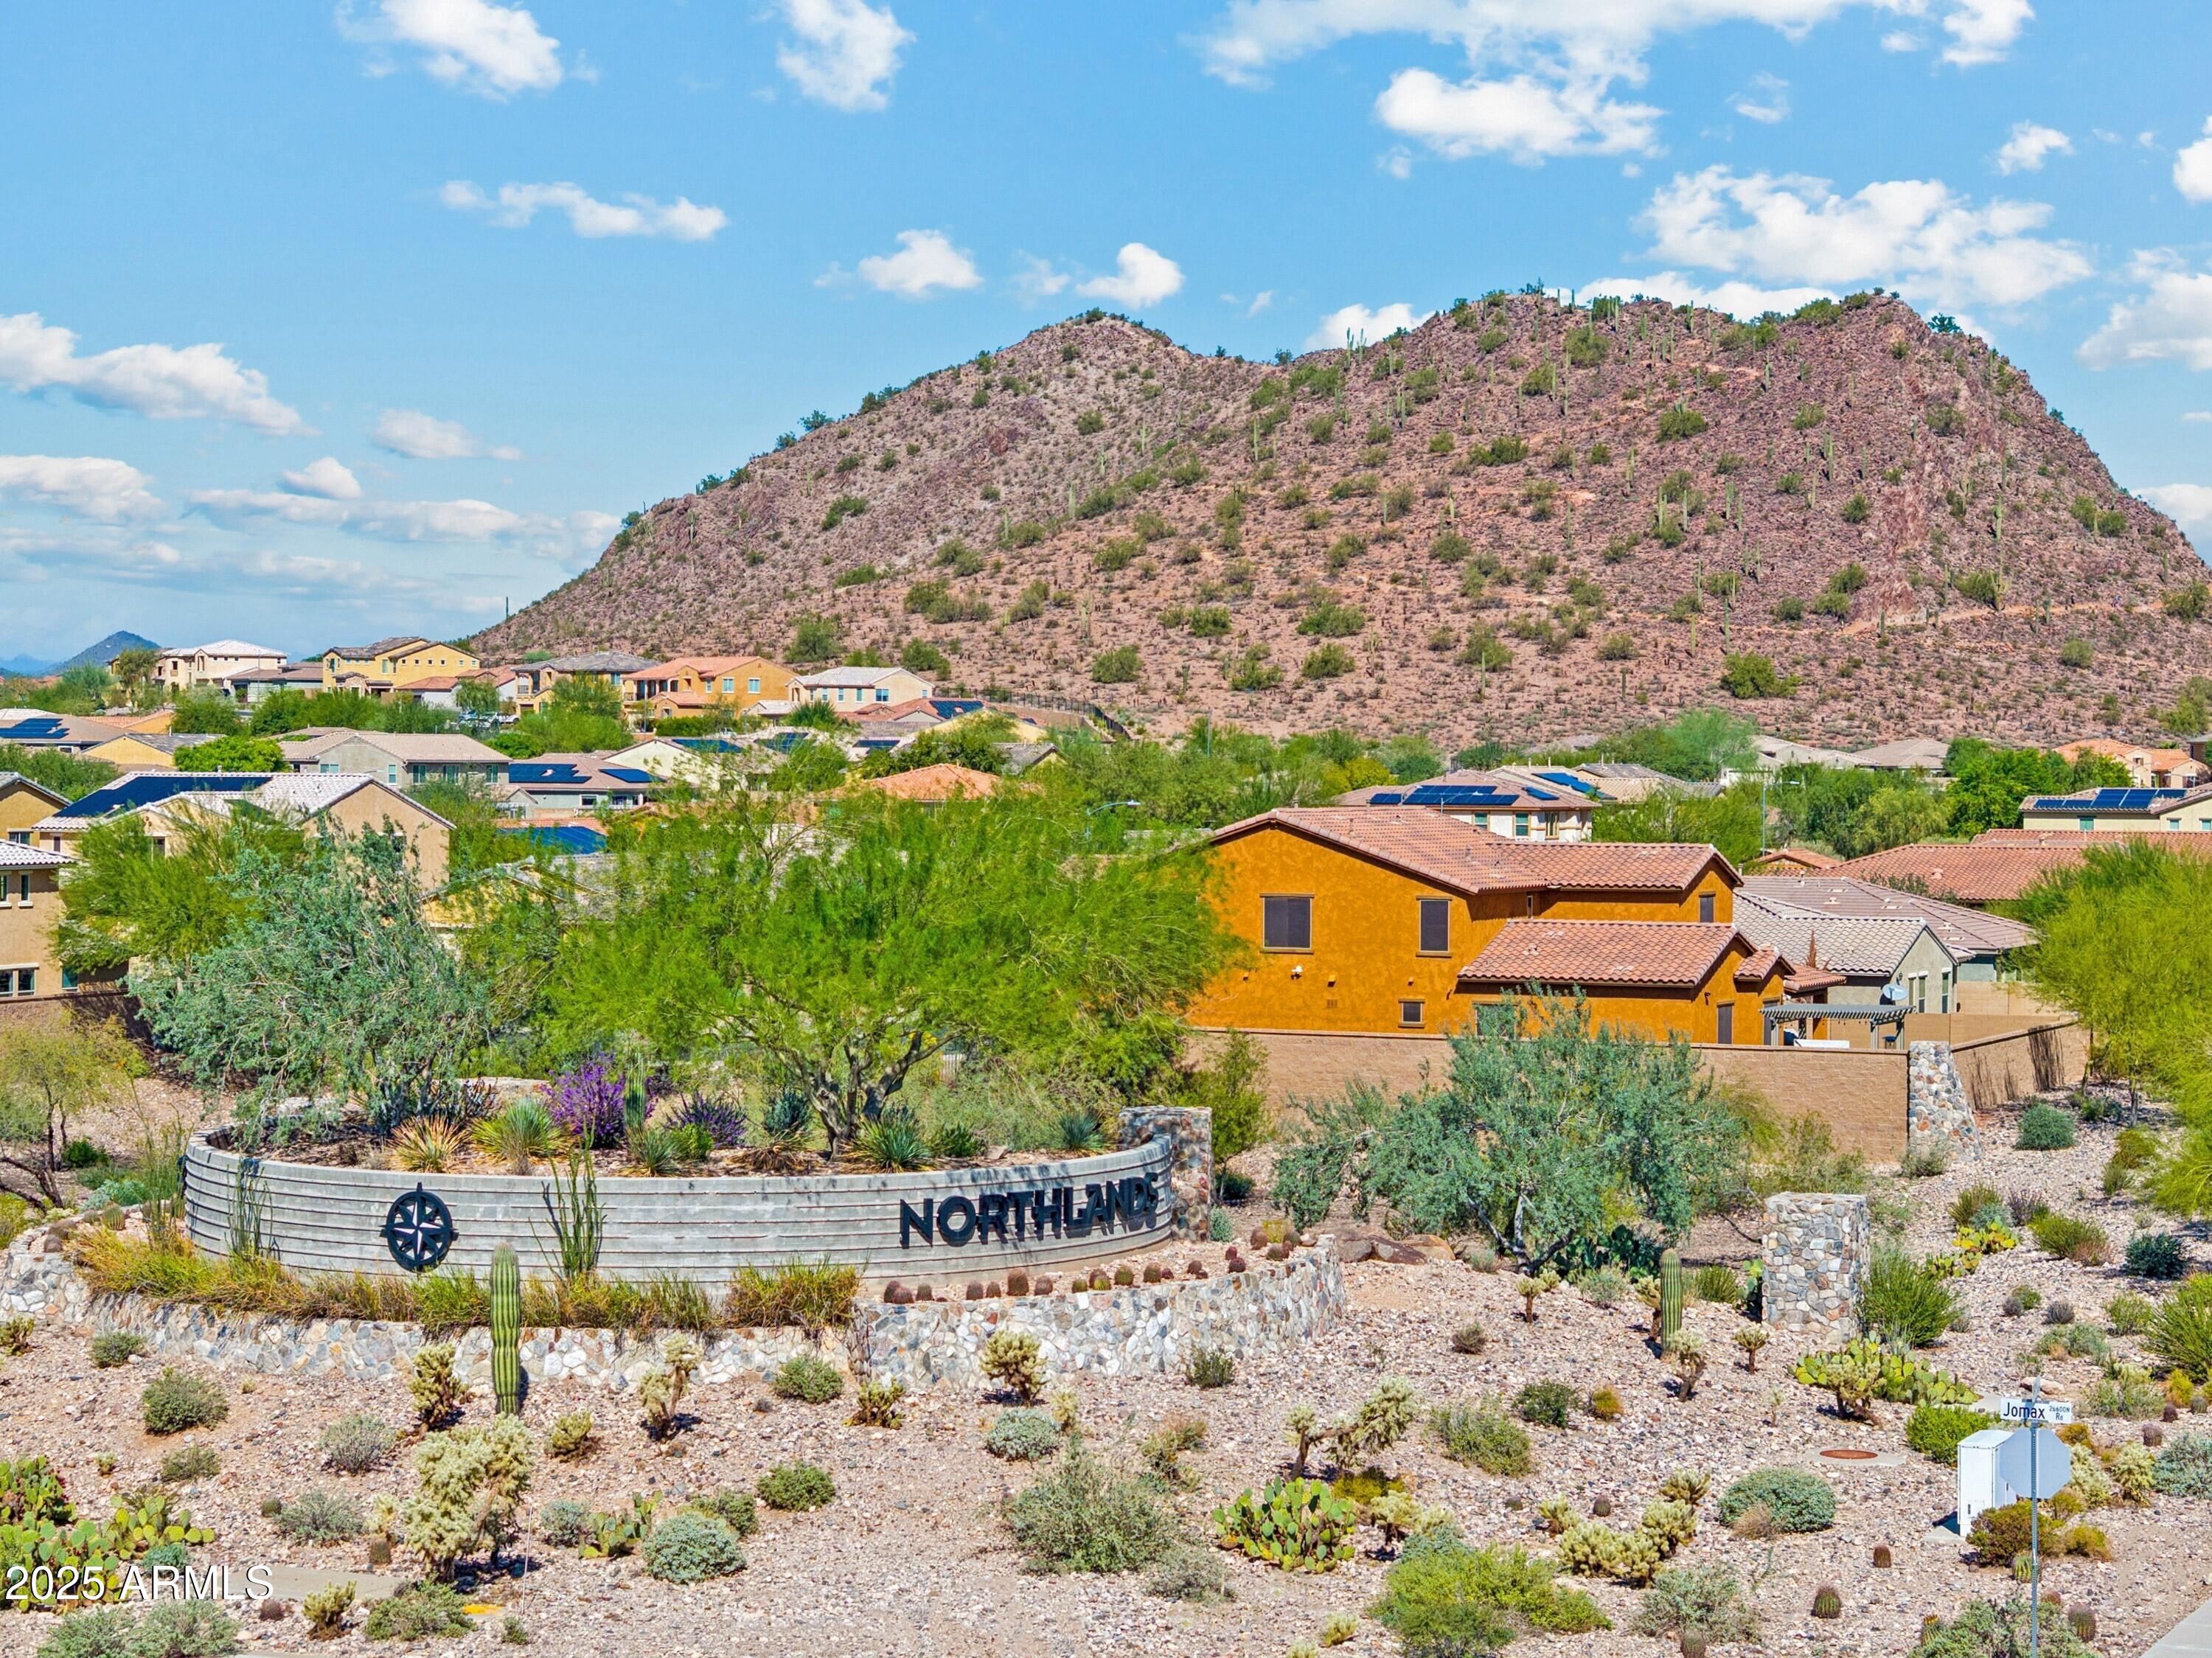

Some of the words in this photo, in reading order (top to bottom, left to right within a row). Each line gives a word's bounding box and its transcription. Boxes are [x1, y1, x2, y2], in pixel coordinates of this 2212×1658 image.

[900, 1171, 1159, 1247] NORTHLANDS
[2003, 1402, 2045, 1419] Jomax
[2056, 1413, 2063, 1421] Rd
